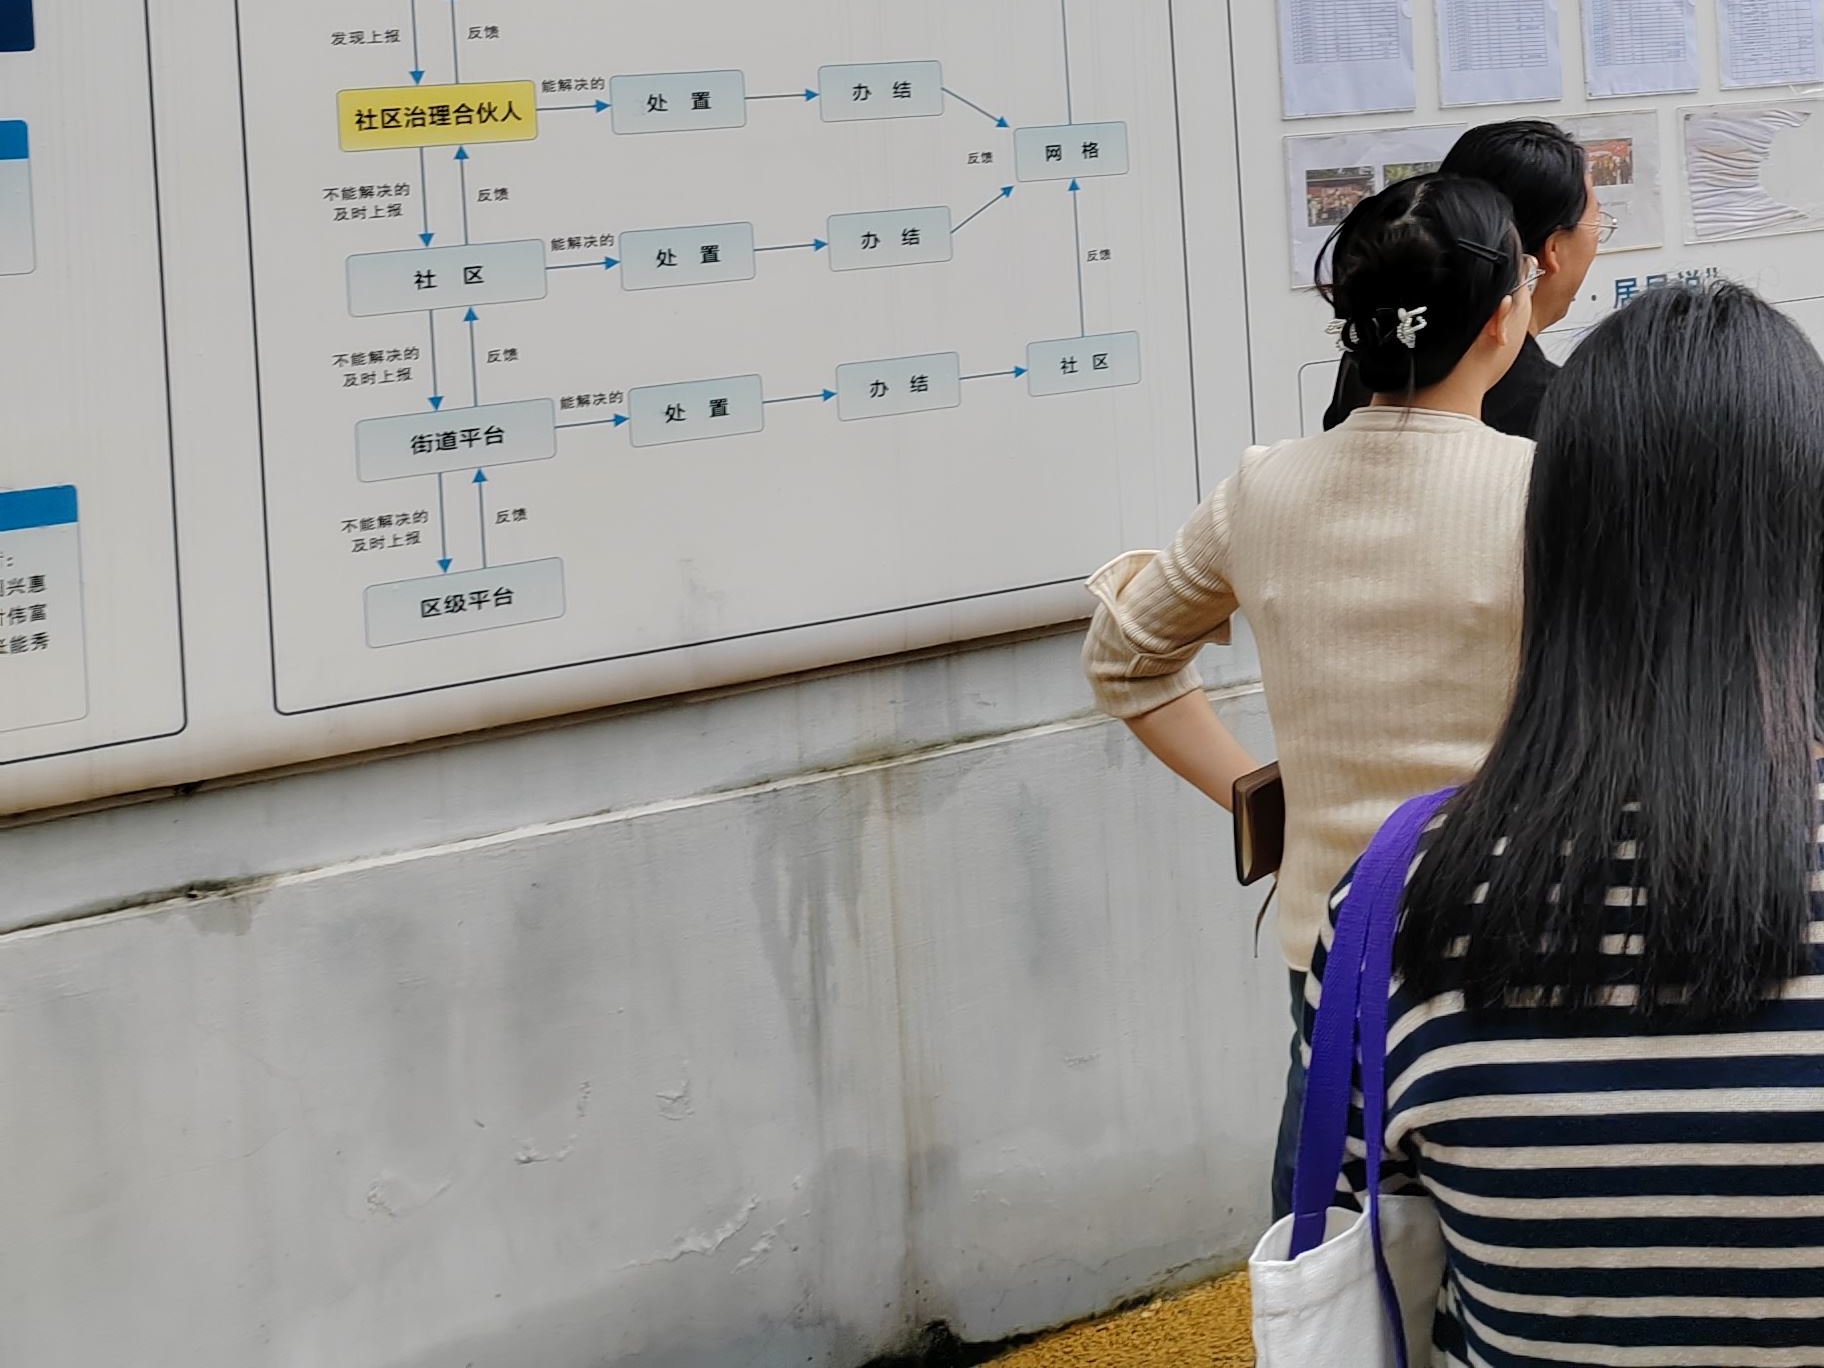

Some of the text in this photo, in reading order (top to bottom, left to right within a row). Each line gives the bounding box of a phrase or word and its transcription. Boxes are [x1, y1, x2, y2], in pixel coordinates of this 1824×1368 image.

[330, 29, 401, 46] 发现上报
[467, 25, 500, 40] 反馈
[541, 76, 605, 94] 能解决的
[852, 80, 912, 102] 办结
[646, 91, 712, 113] 处置
[354, 100, 522, 132] 社区治理合伙人
[967, 151, 993, 165] 反馈
[1045, 141, 1099, 162] 网格
[322, 183, 410, 201] 不能解决的
[476, 187, 509, 203] 反馈
[333, 203, 404, 222] 及时上报
[550, 233, 615, 252] 能解决的
[861, 228, 921, 250] 办结
[655, 244, 721, 268] 处置
[1086, 248, 1112, 263] 反馈
[413, 265, 485, 290] 社区
[332, 346, 420, 367] 不能解决的
[486, 347, 518, 364] 反馈
[1059, 352, 1109, 375] 社区
[342, 367, 413, 388] 及时上报
[869, 374, 929, 399] 办结
[559, 390, 624, 410] 能解决的
[664, 397, 730, 424] 处置
[410, 425, 505, 455] 街道平台
[341, 510, 429, 533] 不能解决的
[495, 507, 528, 525] 反馈
[351, 531, 422, 553] 及时上报
[420, 586, 515, 619] 区级平台
